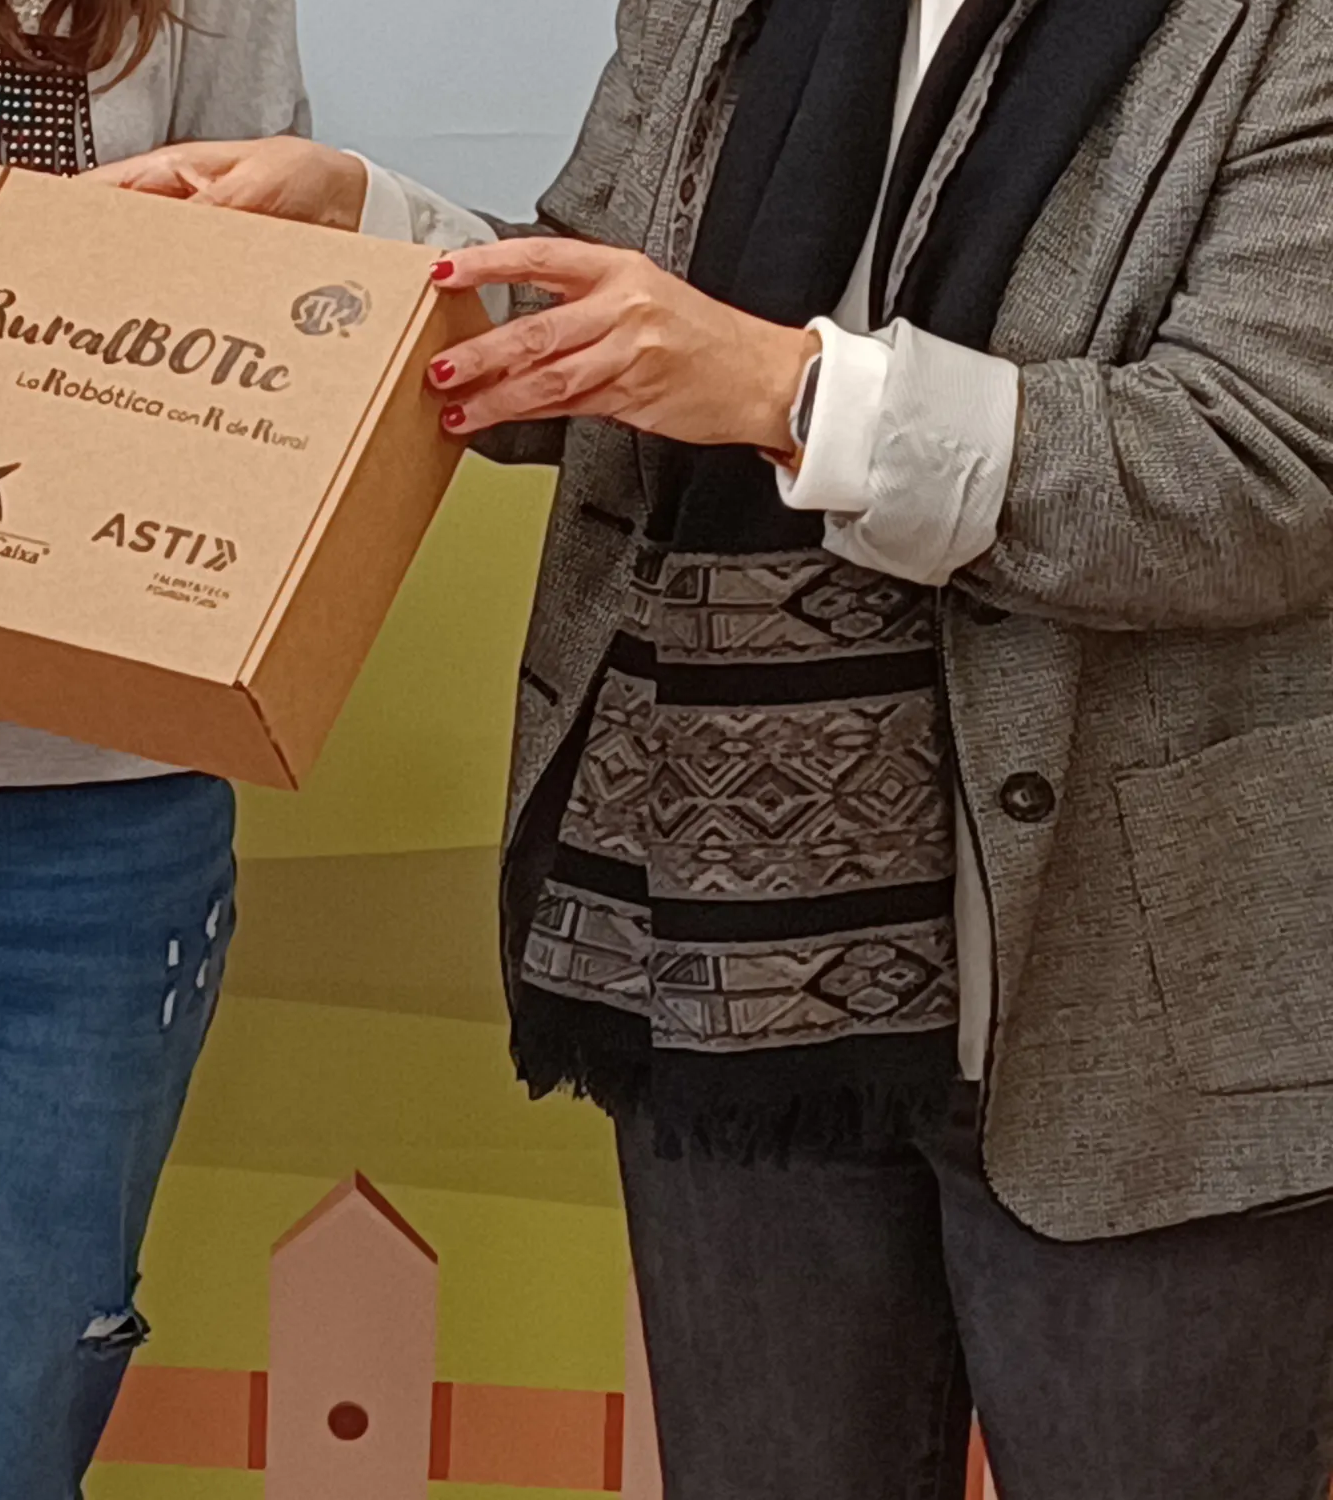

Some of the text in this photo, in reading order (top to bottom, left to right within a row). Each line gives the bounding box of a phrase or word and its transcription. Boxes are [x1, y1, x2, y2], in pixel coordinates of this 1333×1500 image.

[16, 367, 309, 451] La Robótica con R de Rural
[91, 512, 207, 565] ASTI
